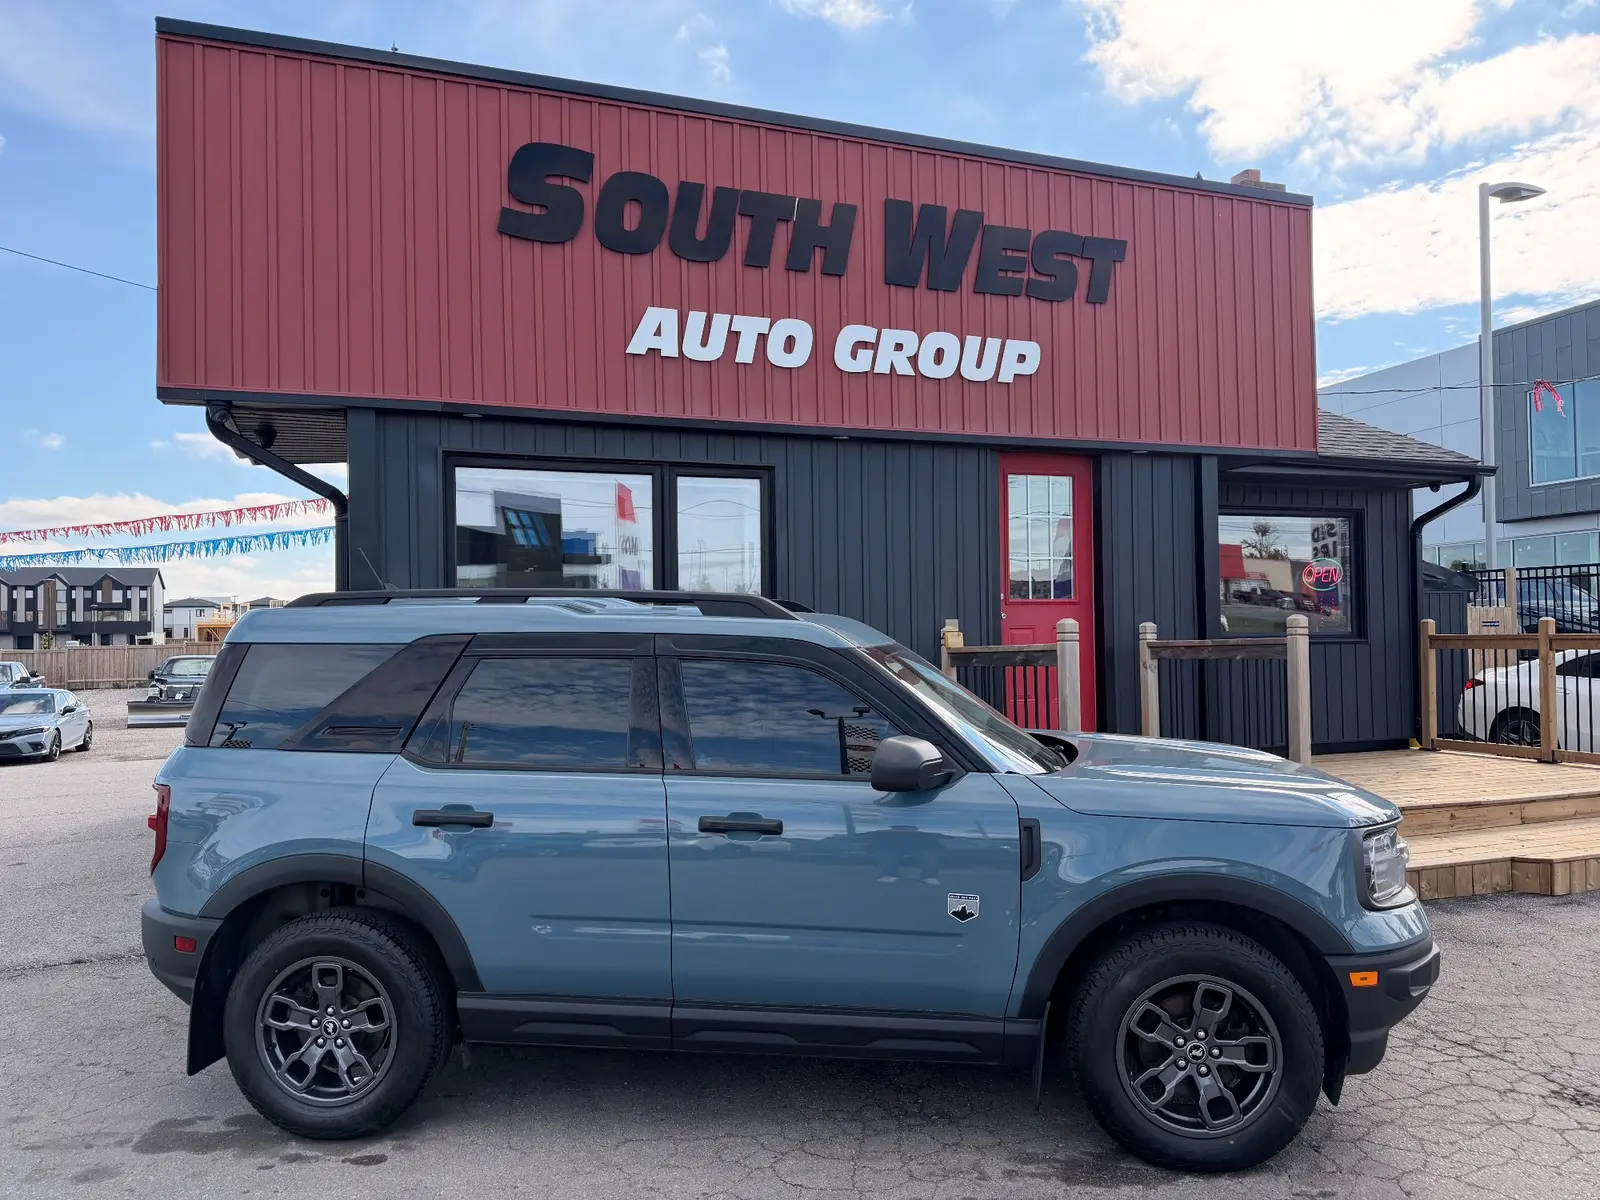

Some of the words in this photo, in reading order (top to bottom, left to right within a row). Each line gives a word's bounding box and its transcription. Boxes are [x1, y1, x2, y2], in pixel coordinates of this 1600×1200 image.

[498, 142, 857, 276] SOUTH
[885, 198, 1127, 304] WEST
[626, 306, 813, 369] AUTO
[834, 324, 1041, 383] GROUP
[1305, 566, 1340, 583] OPEN
